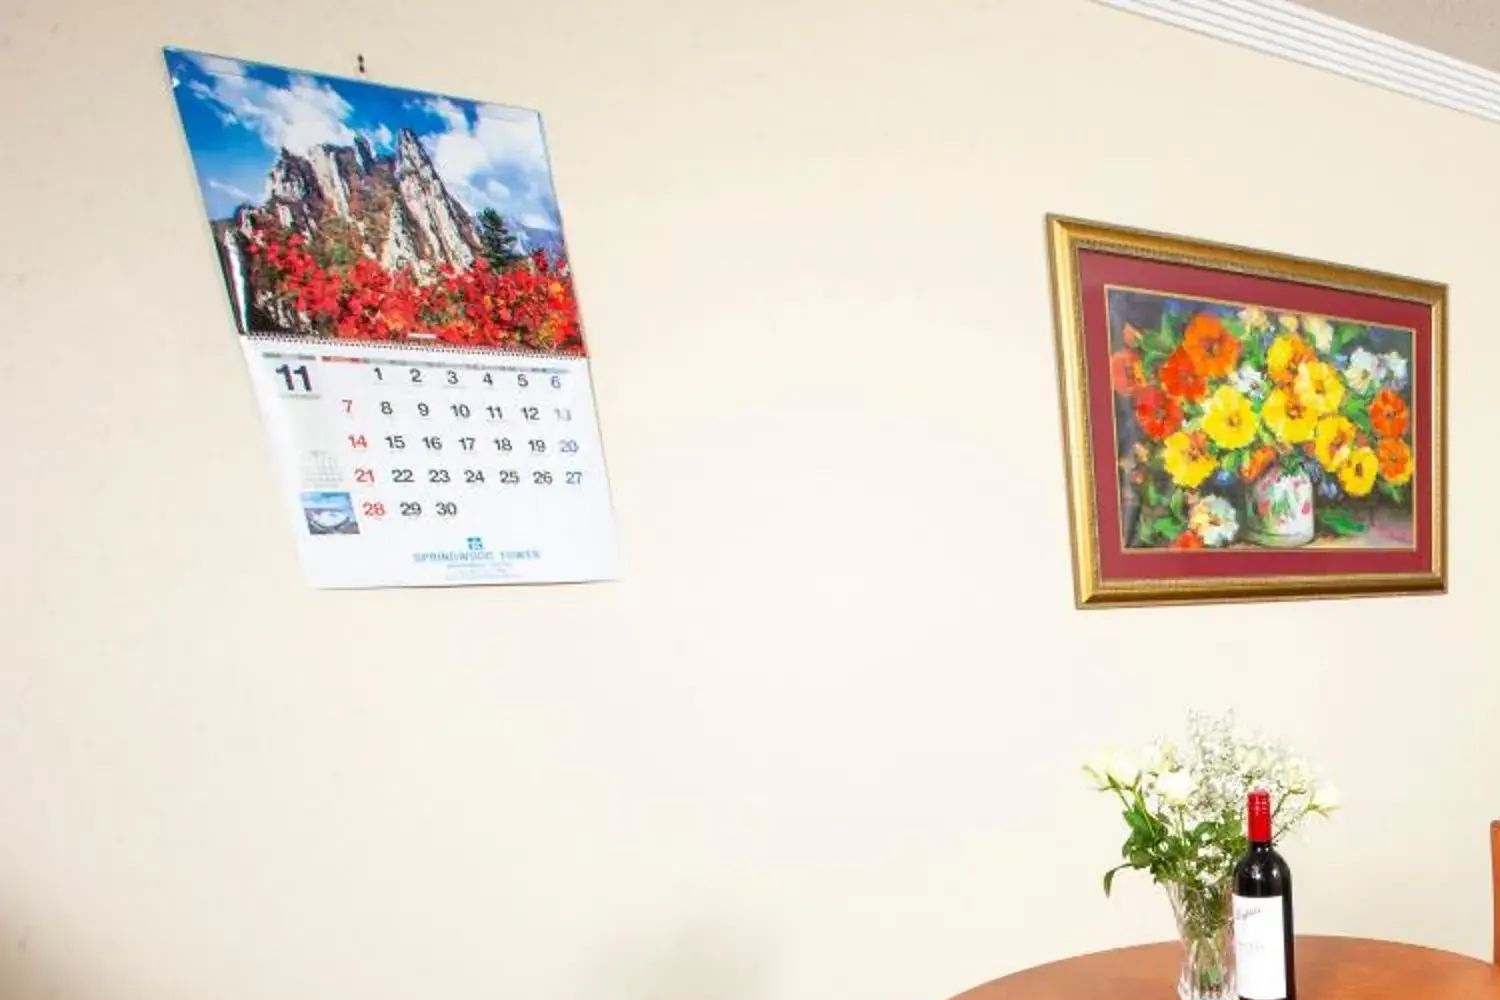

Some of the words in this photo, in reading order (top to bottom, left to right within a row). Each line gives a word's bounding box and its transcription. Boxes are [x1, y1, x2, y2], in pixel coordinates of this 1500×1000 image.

[276, 364, 312, 392] 11
[373, 367, 383, 380] 1
[409, 368, 423, 383] 2
[447, 370, 459, 385] 3
[482, 372, 494, 386] 4
[517, 374, 529, 388] 5
[551, 376, 562, 389] 6
[341, 399, 353, 413] 7
[380, 401, 394, 415] 8
[417, 402, 431, 417] 9
[450, 404, 471, 418] 10
[486, 406, 503, 420] 11
[520, 407, 541, 421] 12
[347, 434, 368, 449] 14
[384, 436, 406, 449] 15
[421, 437, 443, 451] 16
[458, 437, 476, 451] 17
[493, 437, 513, 451] 18
[528, 439, 547, 453] 19
[559, 439, 580, 453] 20
[354, 469, 376, 483] 21
[391, 469, 415, 483] 22
[428, 469, 451, 483] 23
[463, 470, 486, 484] 24
[498, 470, 521, 485] 25
[532, 471, 553, 485] 26
[565, 472, 583, 485] 27
[362, 502, 386, 517] 28
[399, 502, 423, 517] 29
[435, 502, 458, 516] 30
